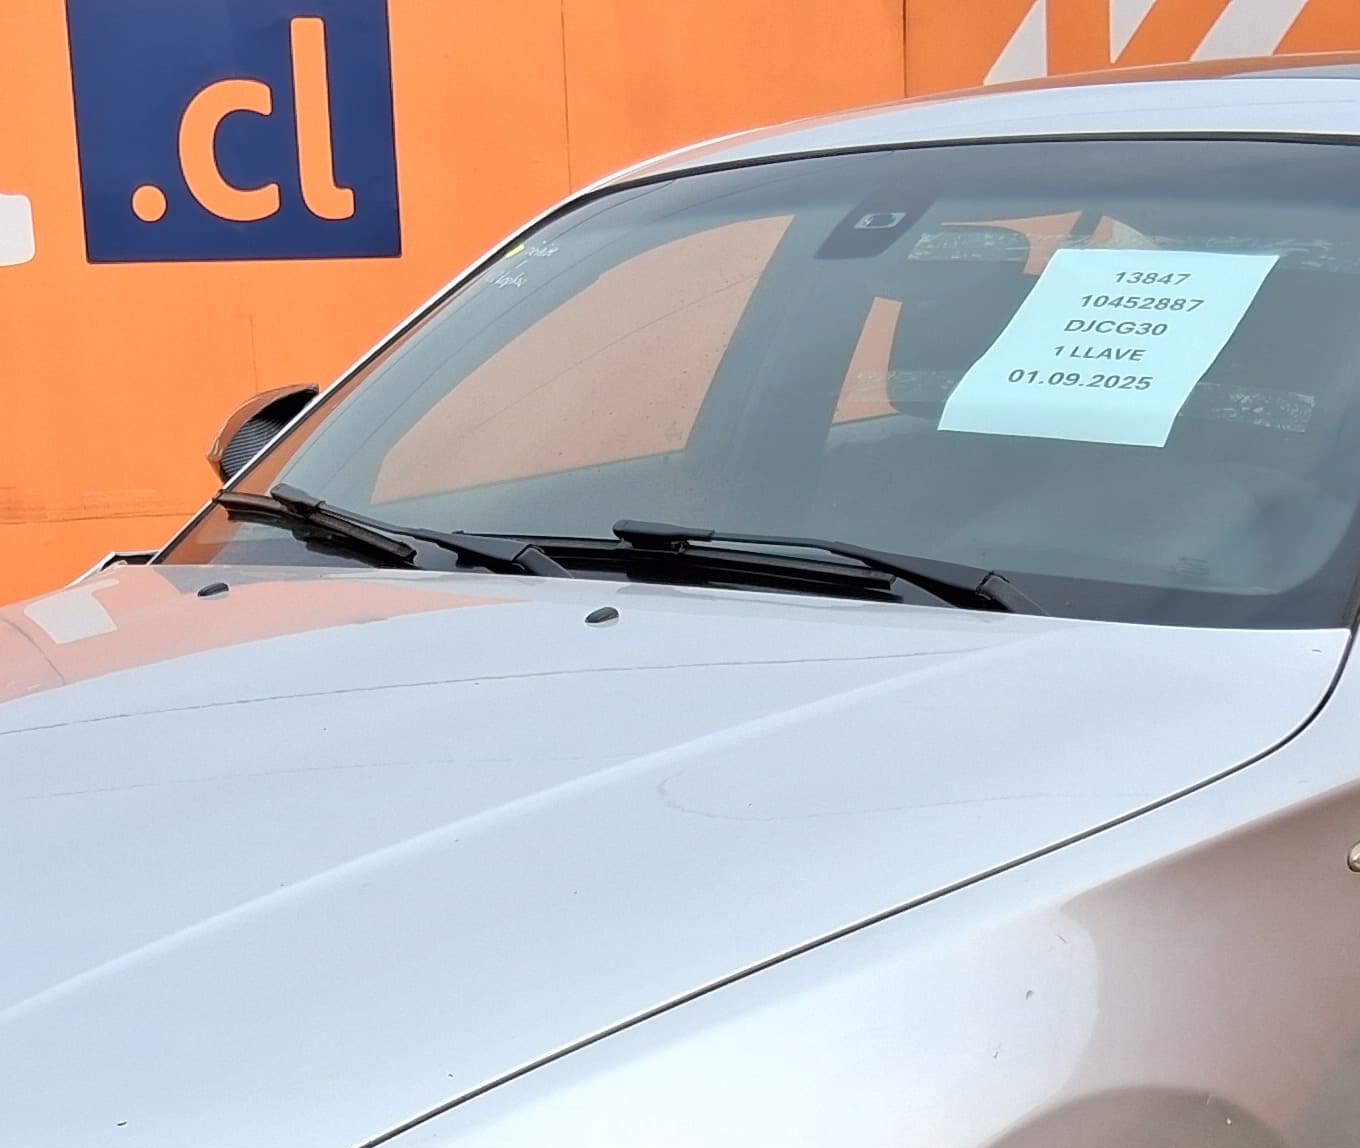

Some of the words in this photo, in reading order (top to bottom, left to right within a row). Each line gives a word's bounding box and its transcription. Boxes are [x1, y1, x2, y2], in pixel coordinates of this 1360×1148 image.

[130, 17, 355, 223] .cl
[1114, 270, 1192, 286] 13847
[1081, 294, 1204, 312] 10452887
[1063, 319, 1169, 337] DJCG30
[1053, 345, 1065, 357] 1
[1069, 346, 1147, 362] LLAVE
[1007, 369, 1154, 391] 01.09.2025
